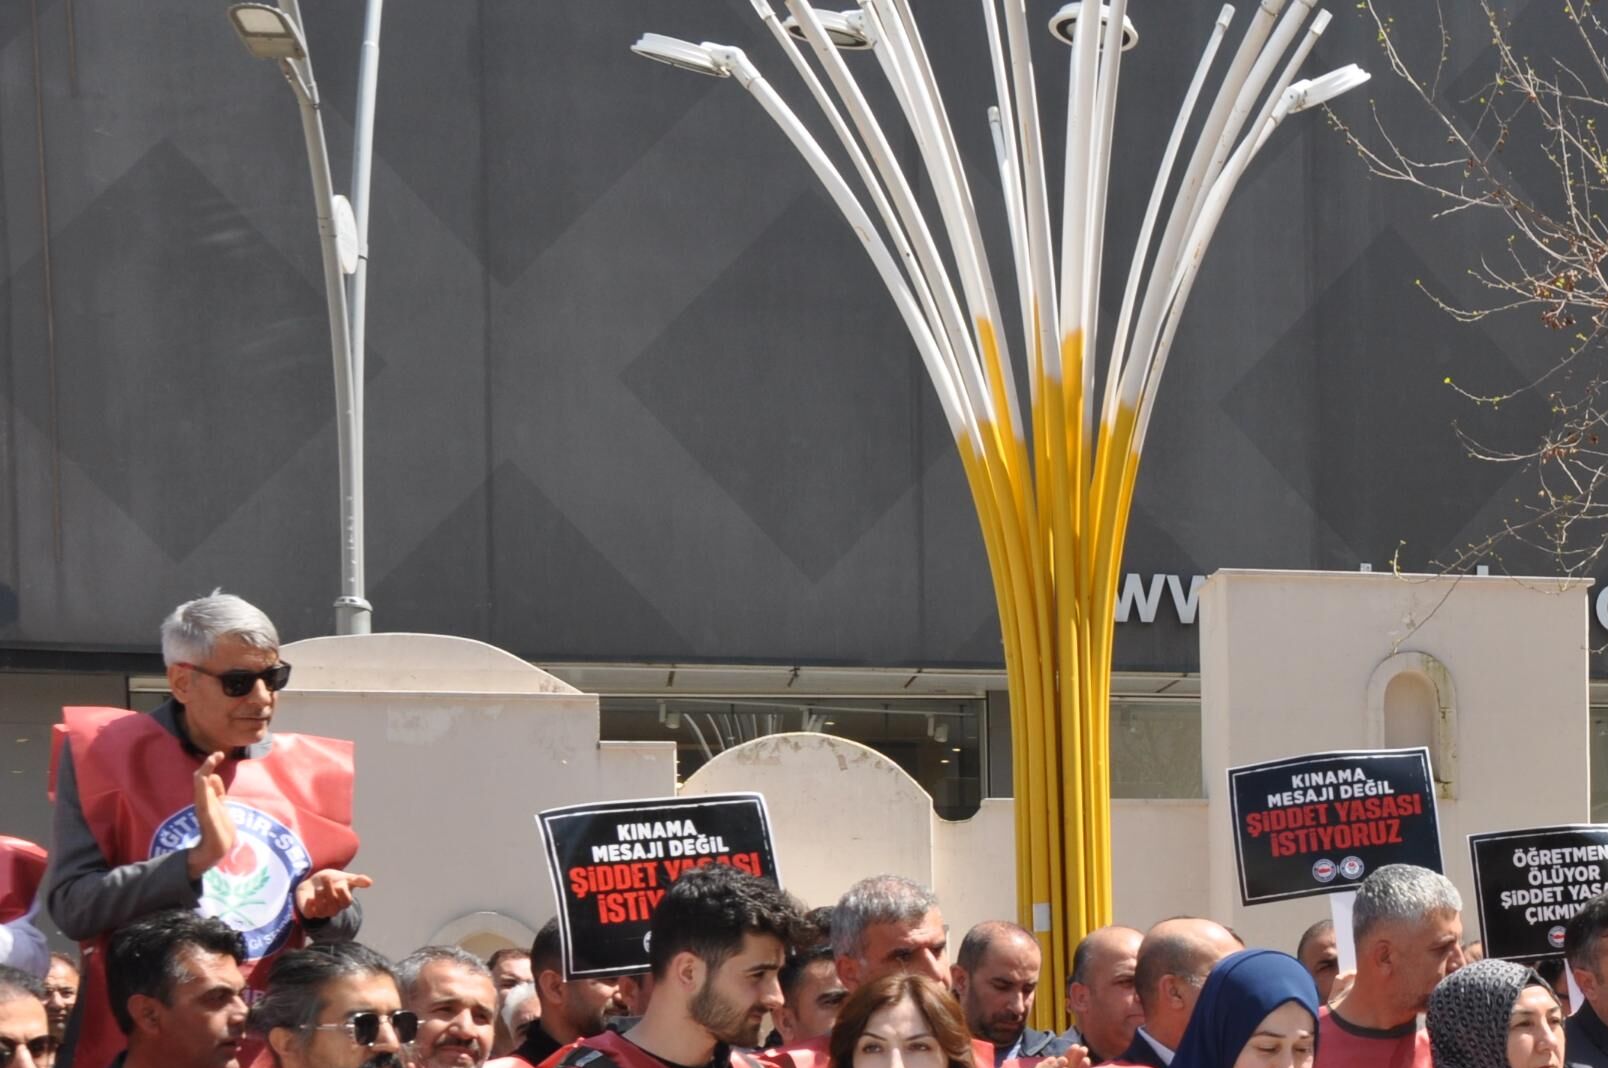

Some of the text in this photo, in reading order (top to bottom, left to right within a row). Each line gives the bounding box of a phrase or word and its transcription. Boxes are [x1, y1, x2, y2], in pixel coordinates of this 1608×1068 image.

[1292, 768, 1366, 789] KINAMA
[1267, 779, 1395, 808] MESAJI DEĞİL
[617, 819, 697, 841] KINAMA
[1247, 794, 1422, 838] ŞİDDET YASASI
[592, 833, 729, 863] MESAJI DEĞİL
[1270, 819, 1402, 857] İSTİYORUZ
[569, 861, 658, 897] ŞİDDET
[1528, 865, 1600, 886] ÖLÜYOR
[1500, 887, 1564, 910] ŞİDDET
